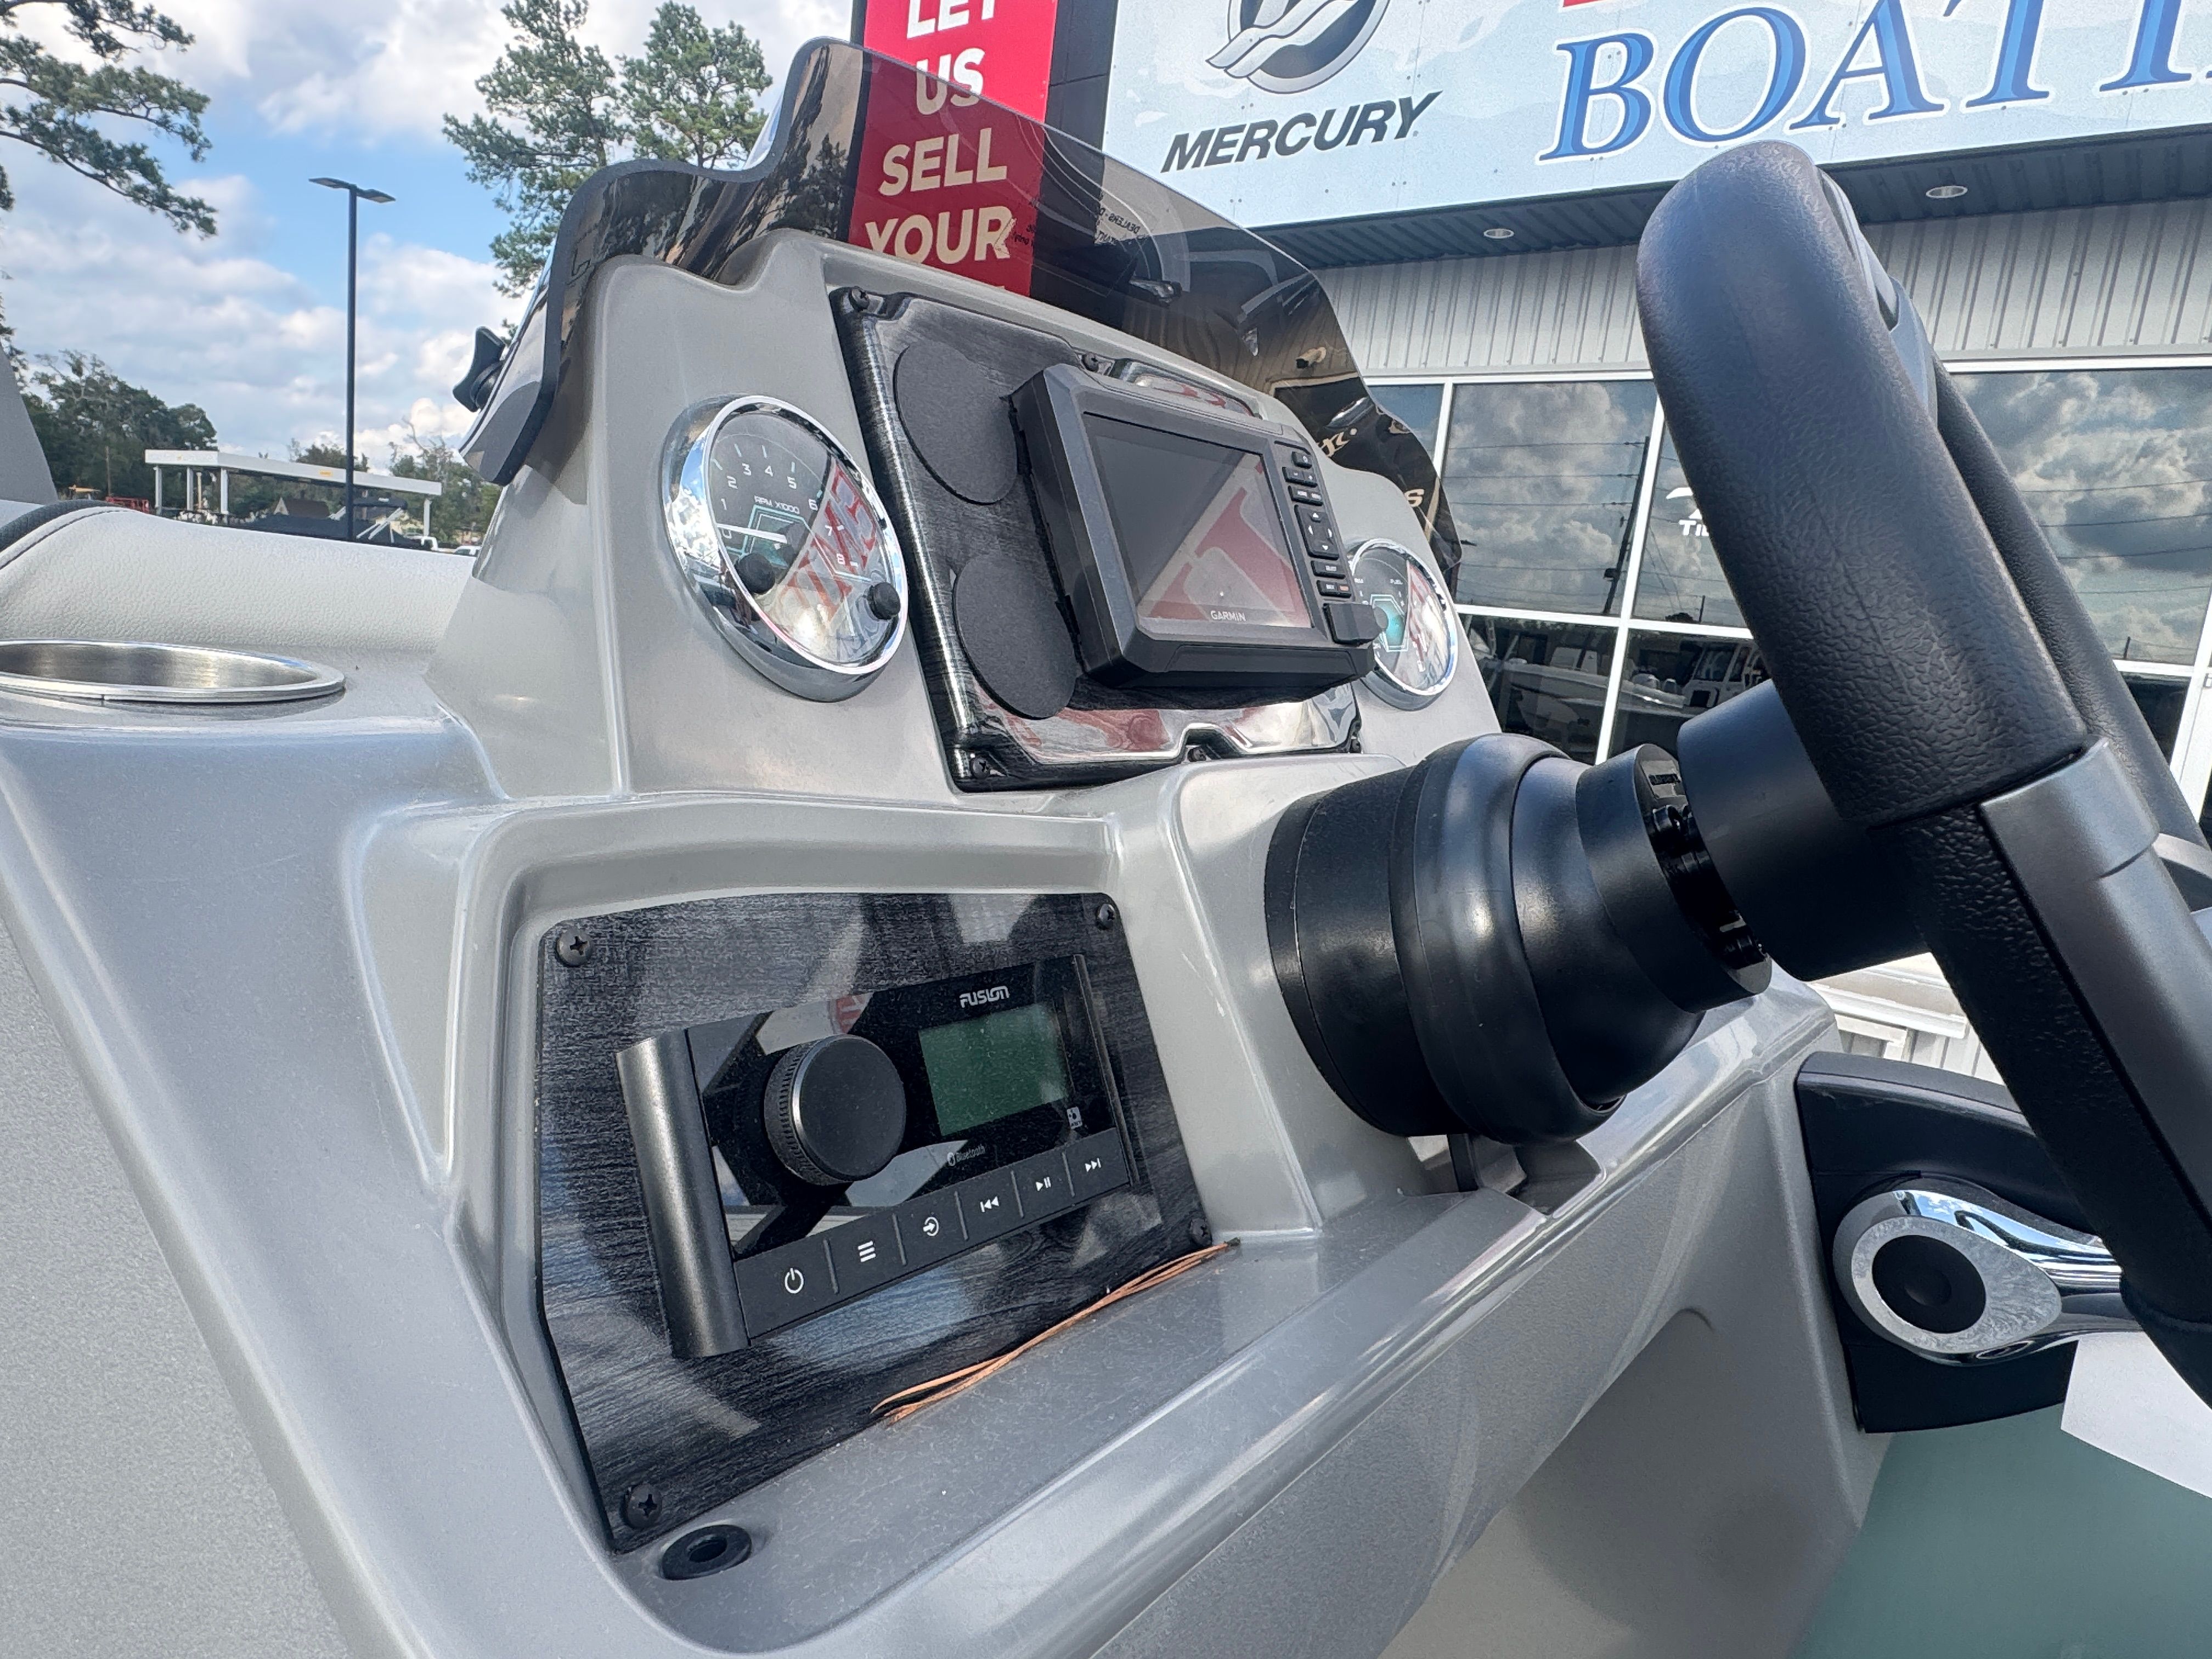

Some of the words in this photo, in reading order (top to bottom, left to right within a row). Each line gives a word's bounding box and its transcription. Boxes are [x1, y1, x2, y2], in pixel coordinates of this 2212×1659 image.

[916, 47, 985, 115] US
[1160, 90, 1443, 173] MERCURY
[878, 127, 1007, 196] SELL
[865, 205, 1014, 264] YOUR
[742, 463, 752, 476] 3
[765, 465, 774, 477] 4
[726, 475, 738, 489] 2
[787, 476, 797, 489] 5
[721, 498, 727, 510] 1
[808, 498, 818, 512] 6
[825, 524, 833, 537] 7
[836, 553, 845, 565] 8
[1210, 610, 1246, 622] GARMIN
[959, 985, 1009, 1008] FUSION
